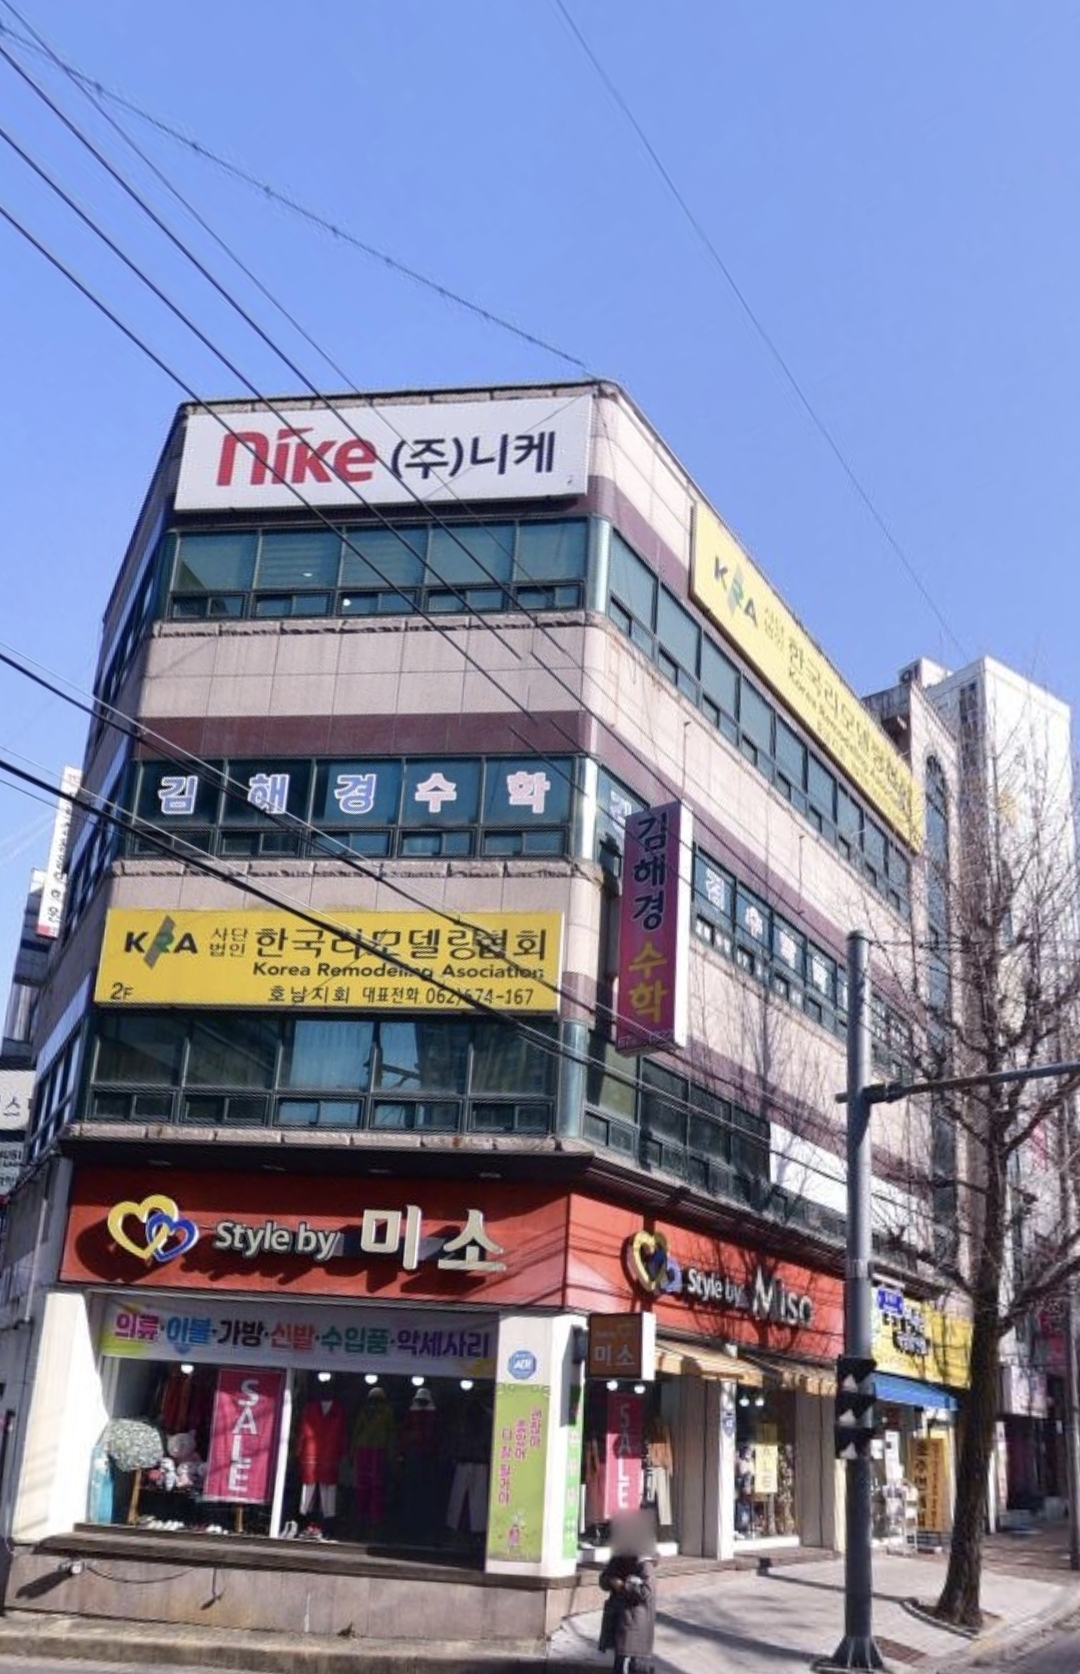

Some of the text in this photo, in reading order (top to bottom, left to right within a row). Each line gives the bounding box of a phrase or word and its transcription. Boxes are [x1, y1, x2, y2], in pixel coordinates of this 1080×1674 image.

[391, 430, 556, 480] (주)니케
[633, 811, 668, 932] 김해경
[123, 929, 199, 955] KRA
[211, 927, 249, 942] 사단
[209, 942, 247, 958] 법인
[253, 962, 311, 977] Korea
[628, 940, 668, 1024] 수학
[110, 982, 134, 1000] 2F
[362, 986, 419, 1004] 대표전화
[213, 1204, 508, 1272] Style by 미소
[687, 1267, 722, 1301] Style
[594, 1343, 635, 1367] 미소
[228, 1379, 259, 1492] SALE
[616, 1403, 632, 1510] SALE
